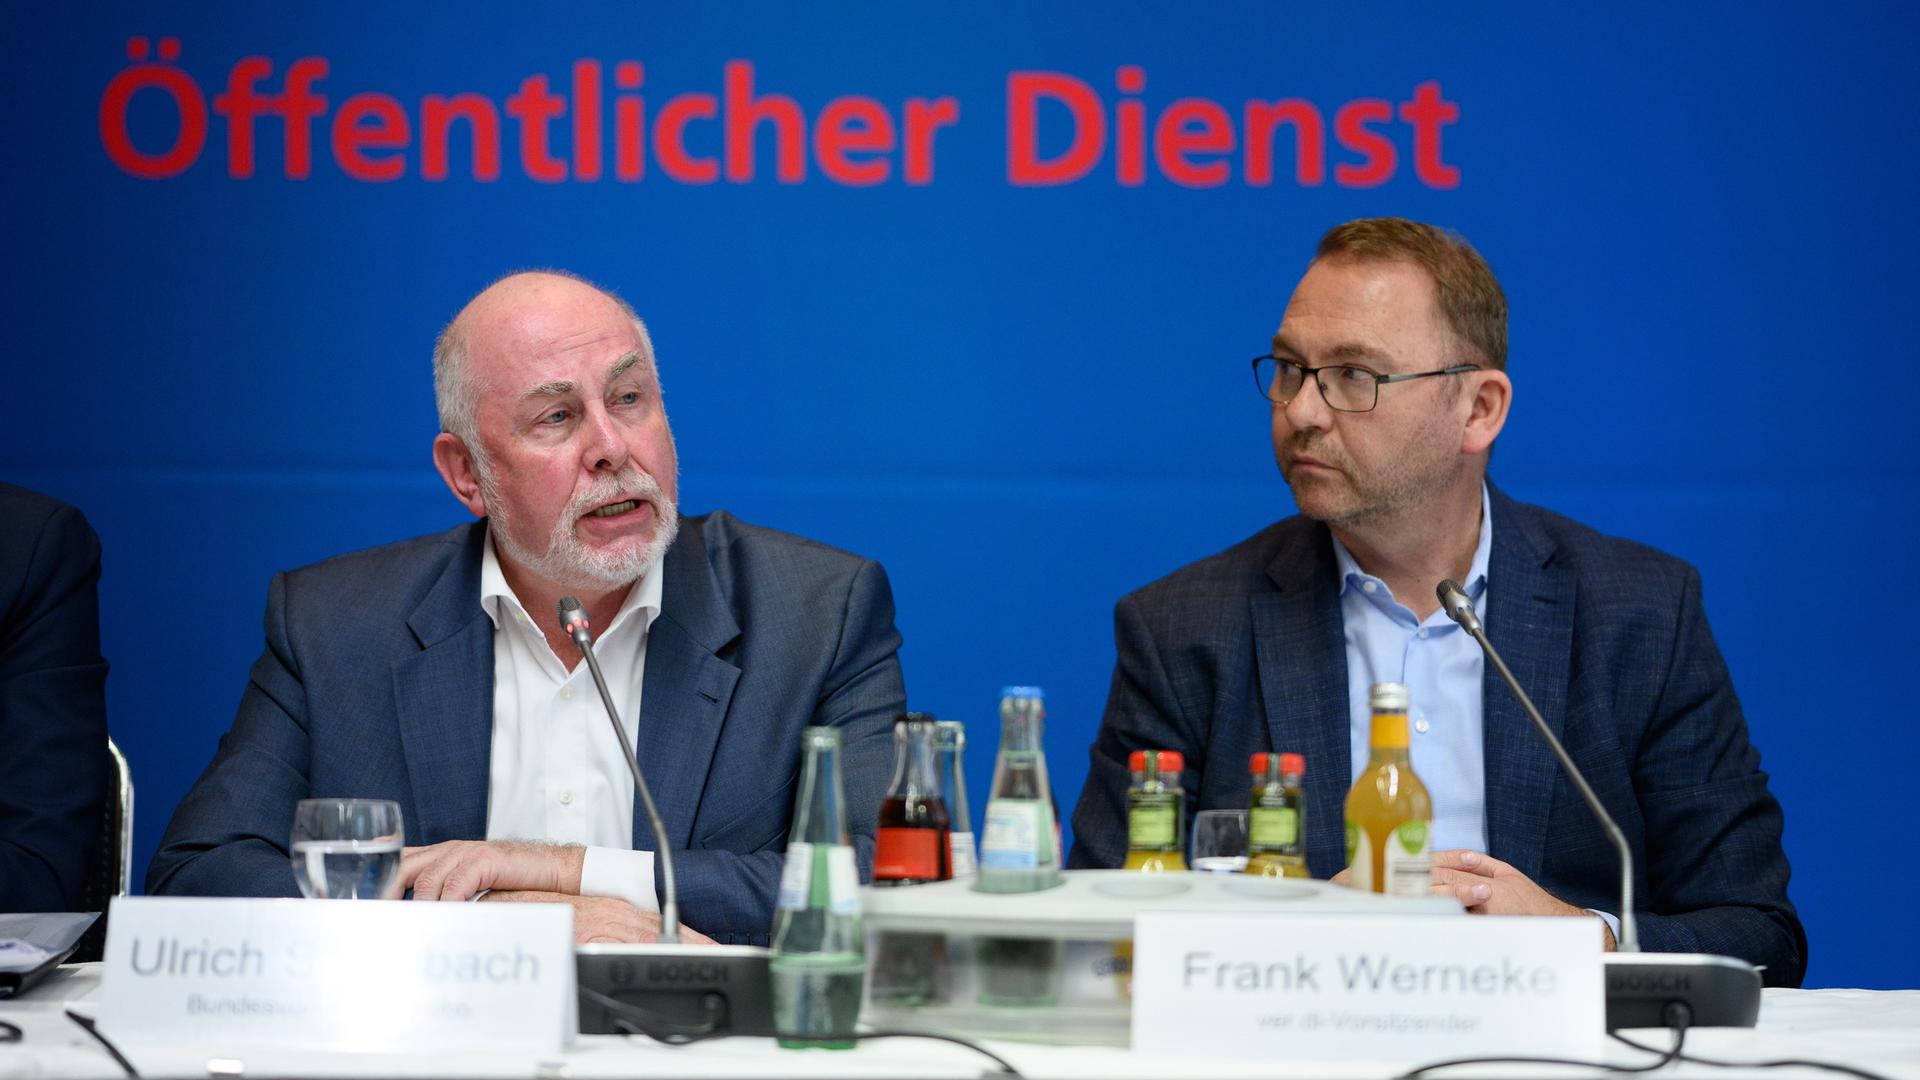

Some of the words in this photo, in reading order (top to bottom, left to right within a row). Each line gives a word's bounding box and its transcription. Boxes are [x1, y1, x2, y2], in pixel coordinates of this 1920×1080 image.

[99, 36, 957, 186] Öffentlicher
[1006, 65, 1461, 189] Dienst
[130, 936, 266, 979] Ulrich
[284, 938, 541, 983] Sbach
[1181, 951, 1321, 992] Frank
[1338, 953, 1557, 995] Werneke
